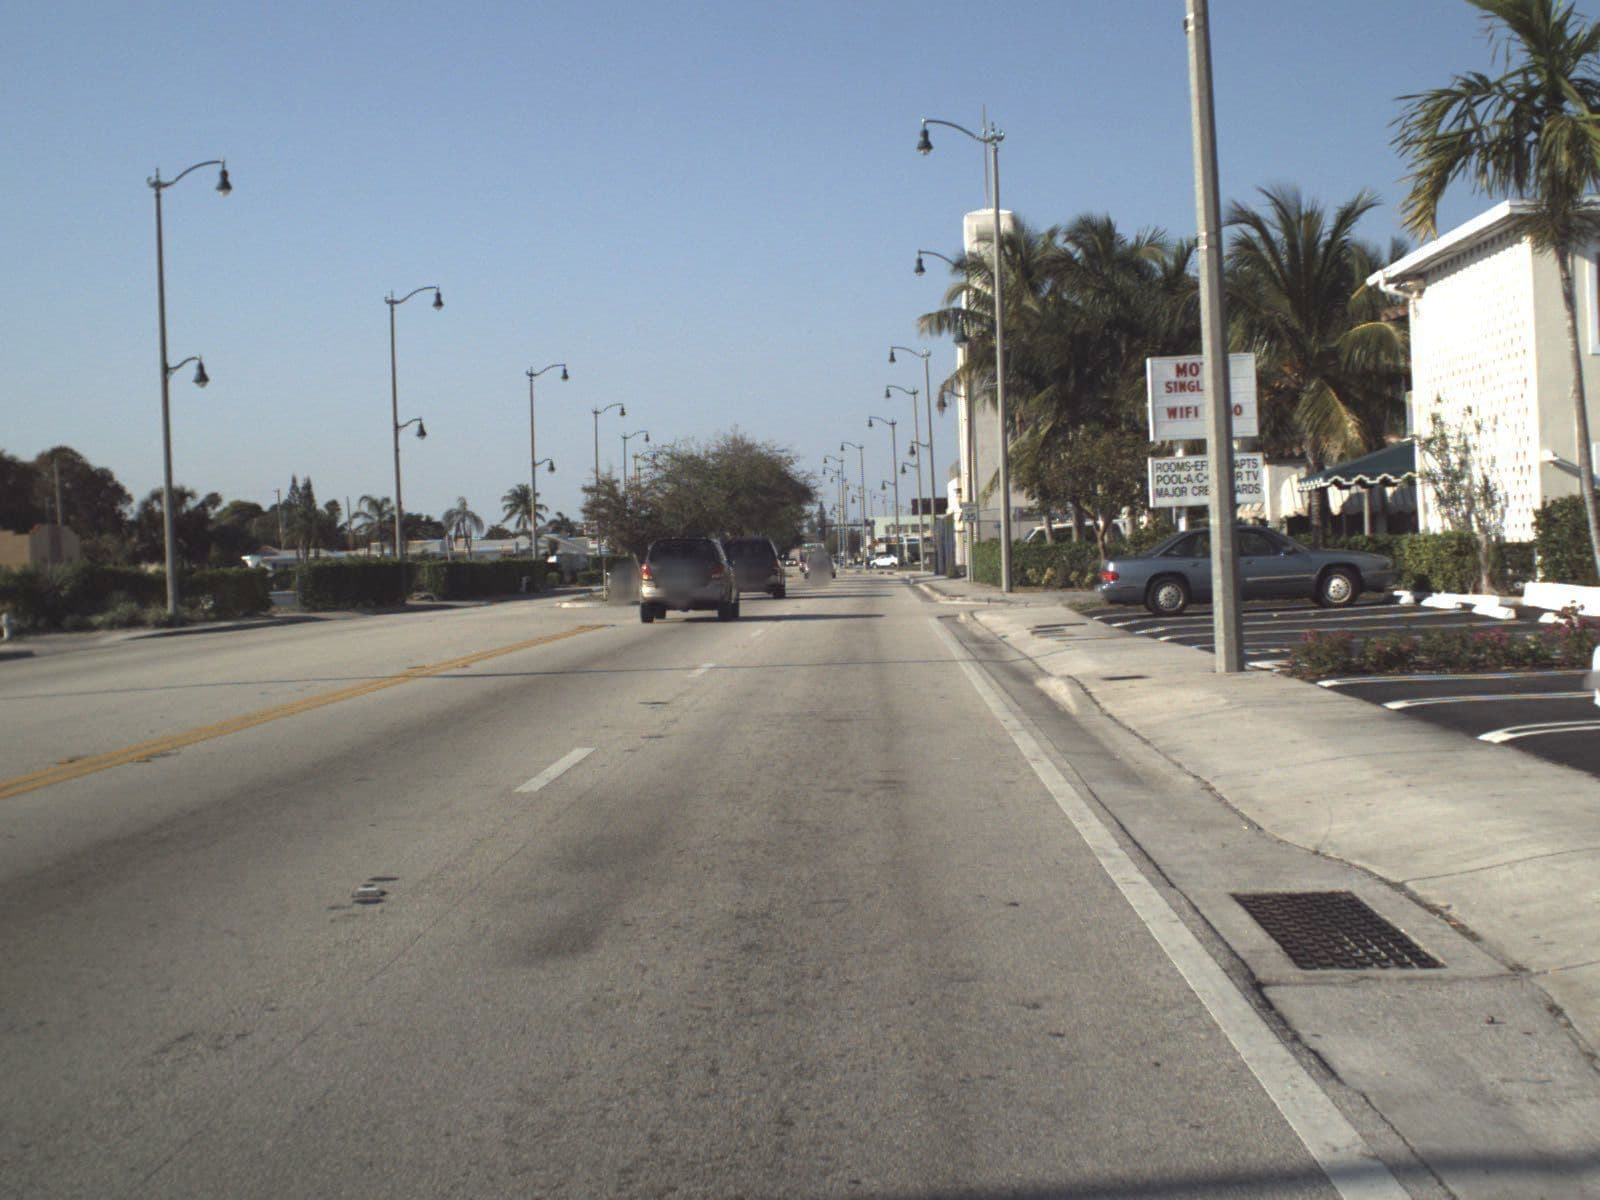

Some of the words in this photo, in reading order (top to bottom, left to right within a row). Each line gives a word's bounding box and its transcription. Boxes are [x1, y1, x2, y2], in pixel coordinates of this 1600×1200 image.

[1175, 362, 1204, 378] MO
[1165, 380, 1204, 394] SINGL
[1167, 405, 1199, 419] WIFI
[1245, 469, 1259, 480] TV
[1155, 486, 1188, 498] MAJOR
[1191, 485, 1210, 496] CRE
[1234, 481, 1261, 494] ARDS
